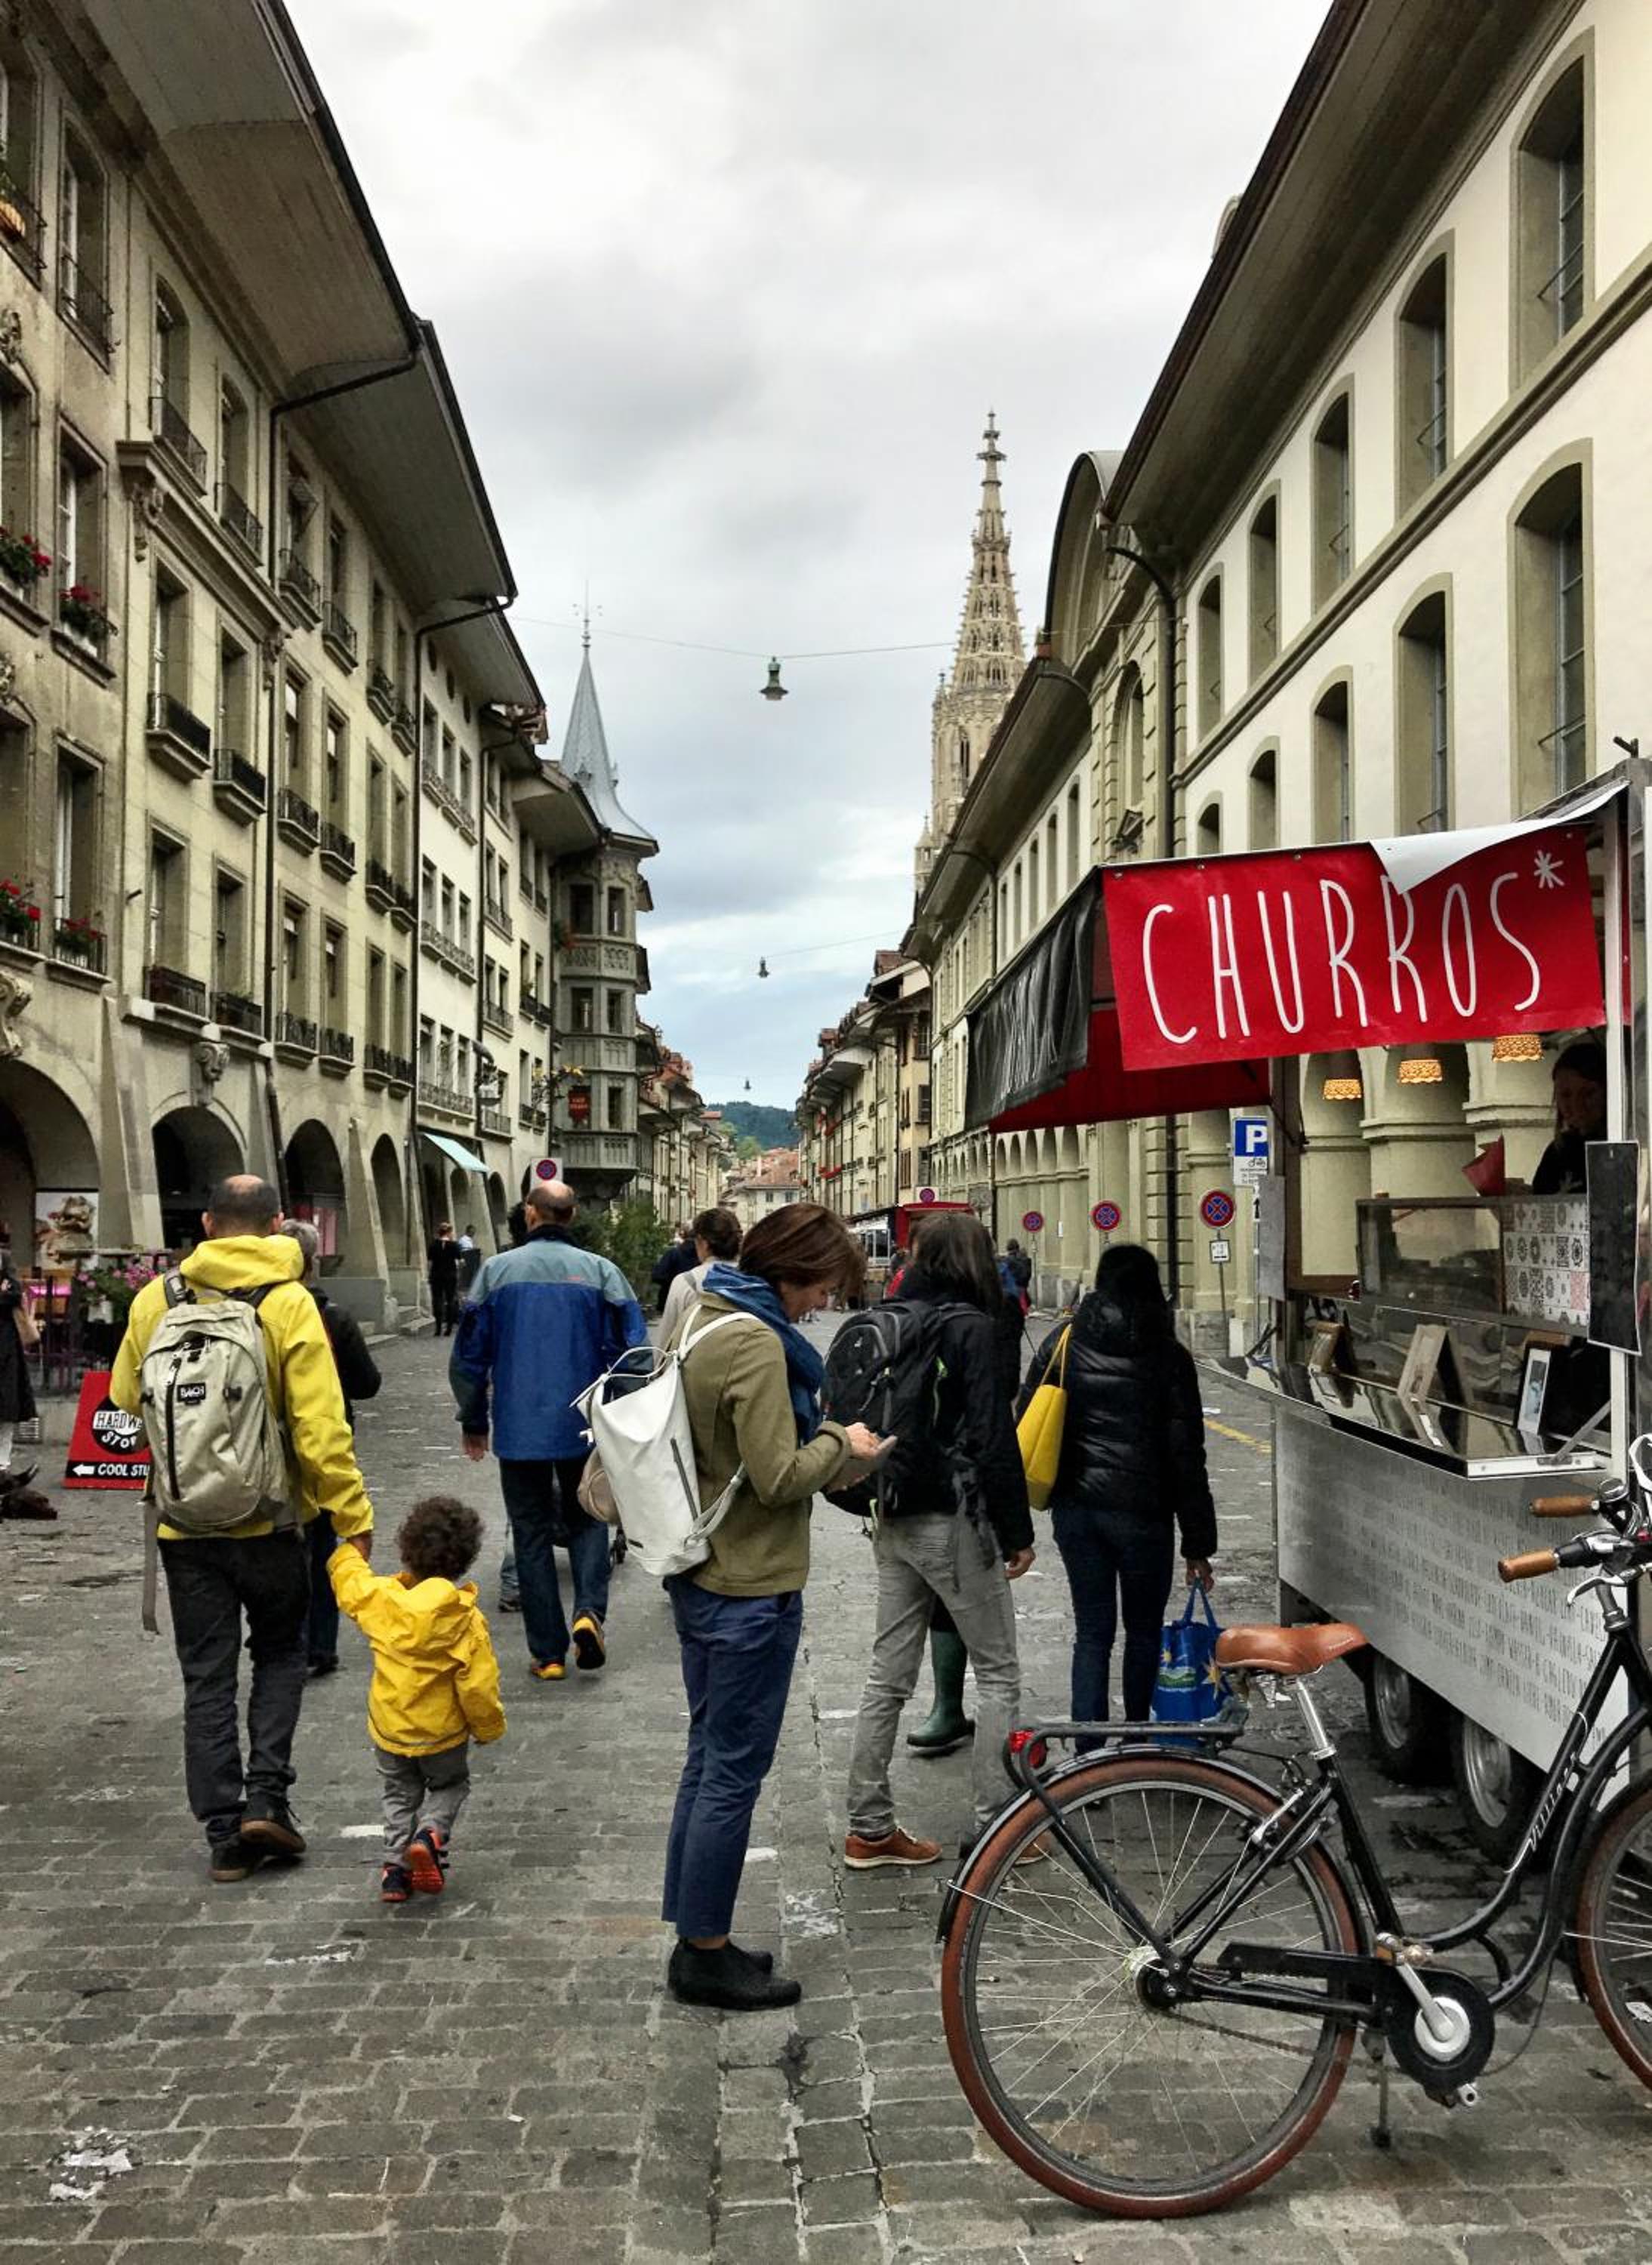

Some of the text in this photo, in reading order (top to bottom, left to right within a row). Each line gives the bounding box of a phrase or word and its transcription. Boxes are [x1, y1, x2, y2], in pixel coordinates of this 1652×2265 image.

[1246, 1124, 1268, 1154] P
[96, 1413, 141, 1429] HARDW
[97, 1462, 128, 1476] COOL
